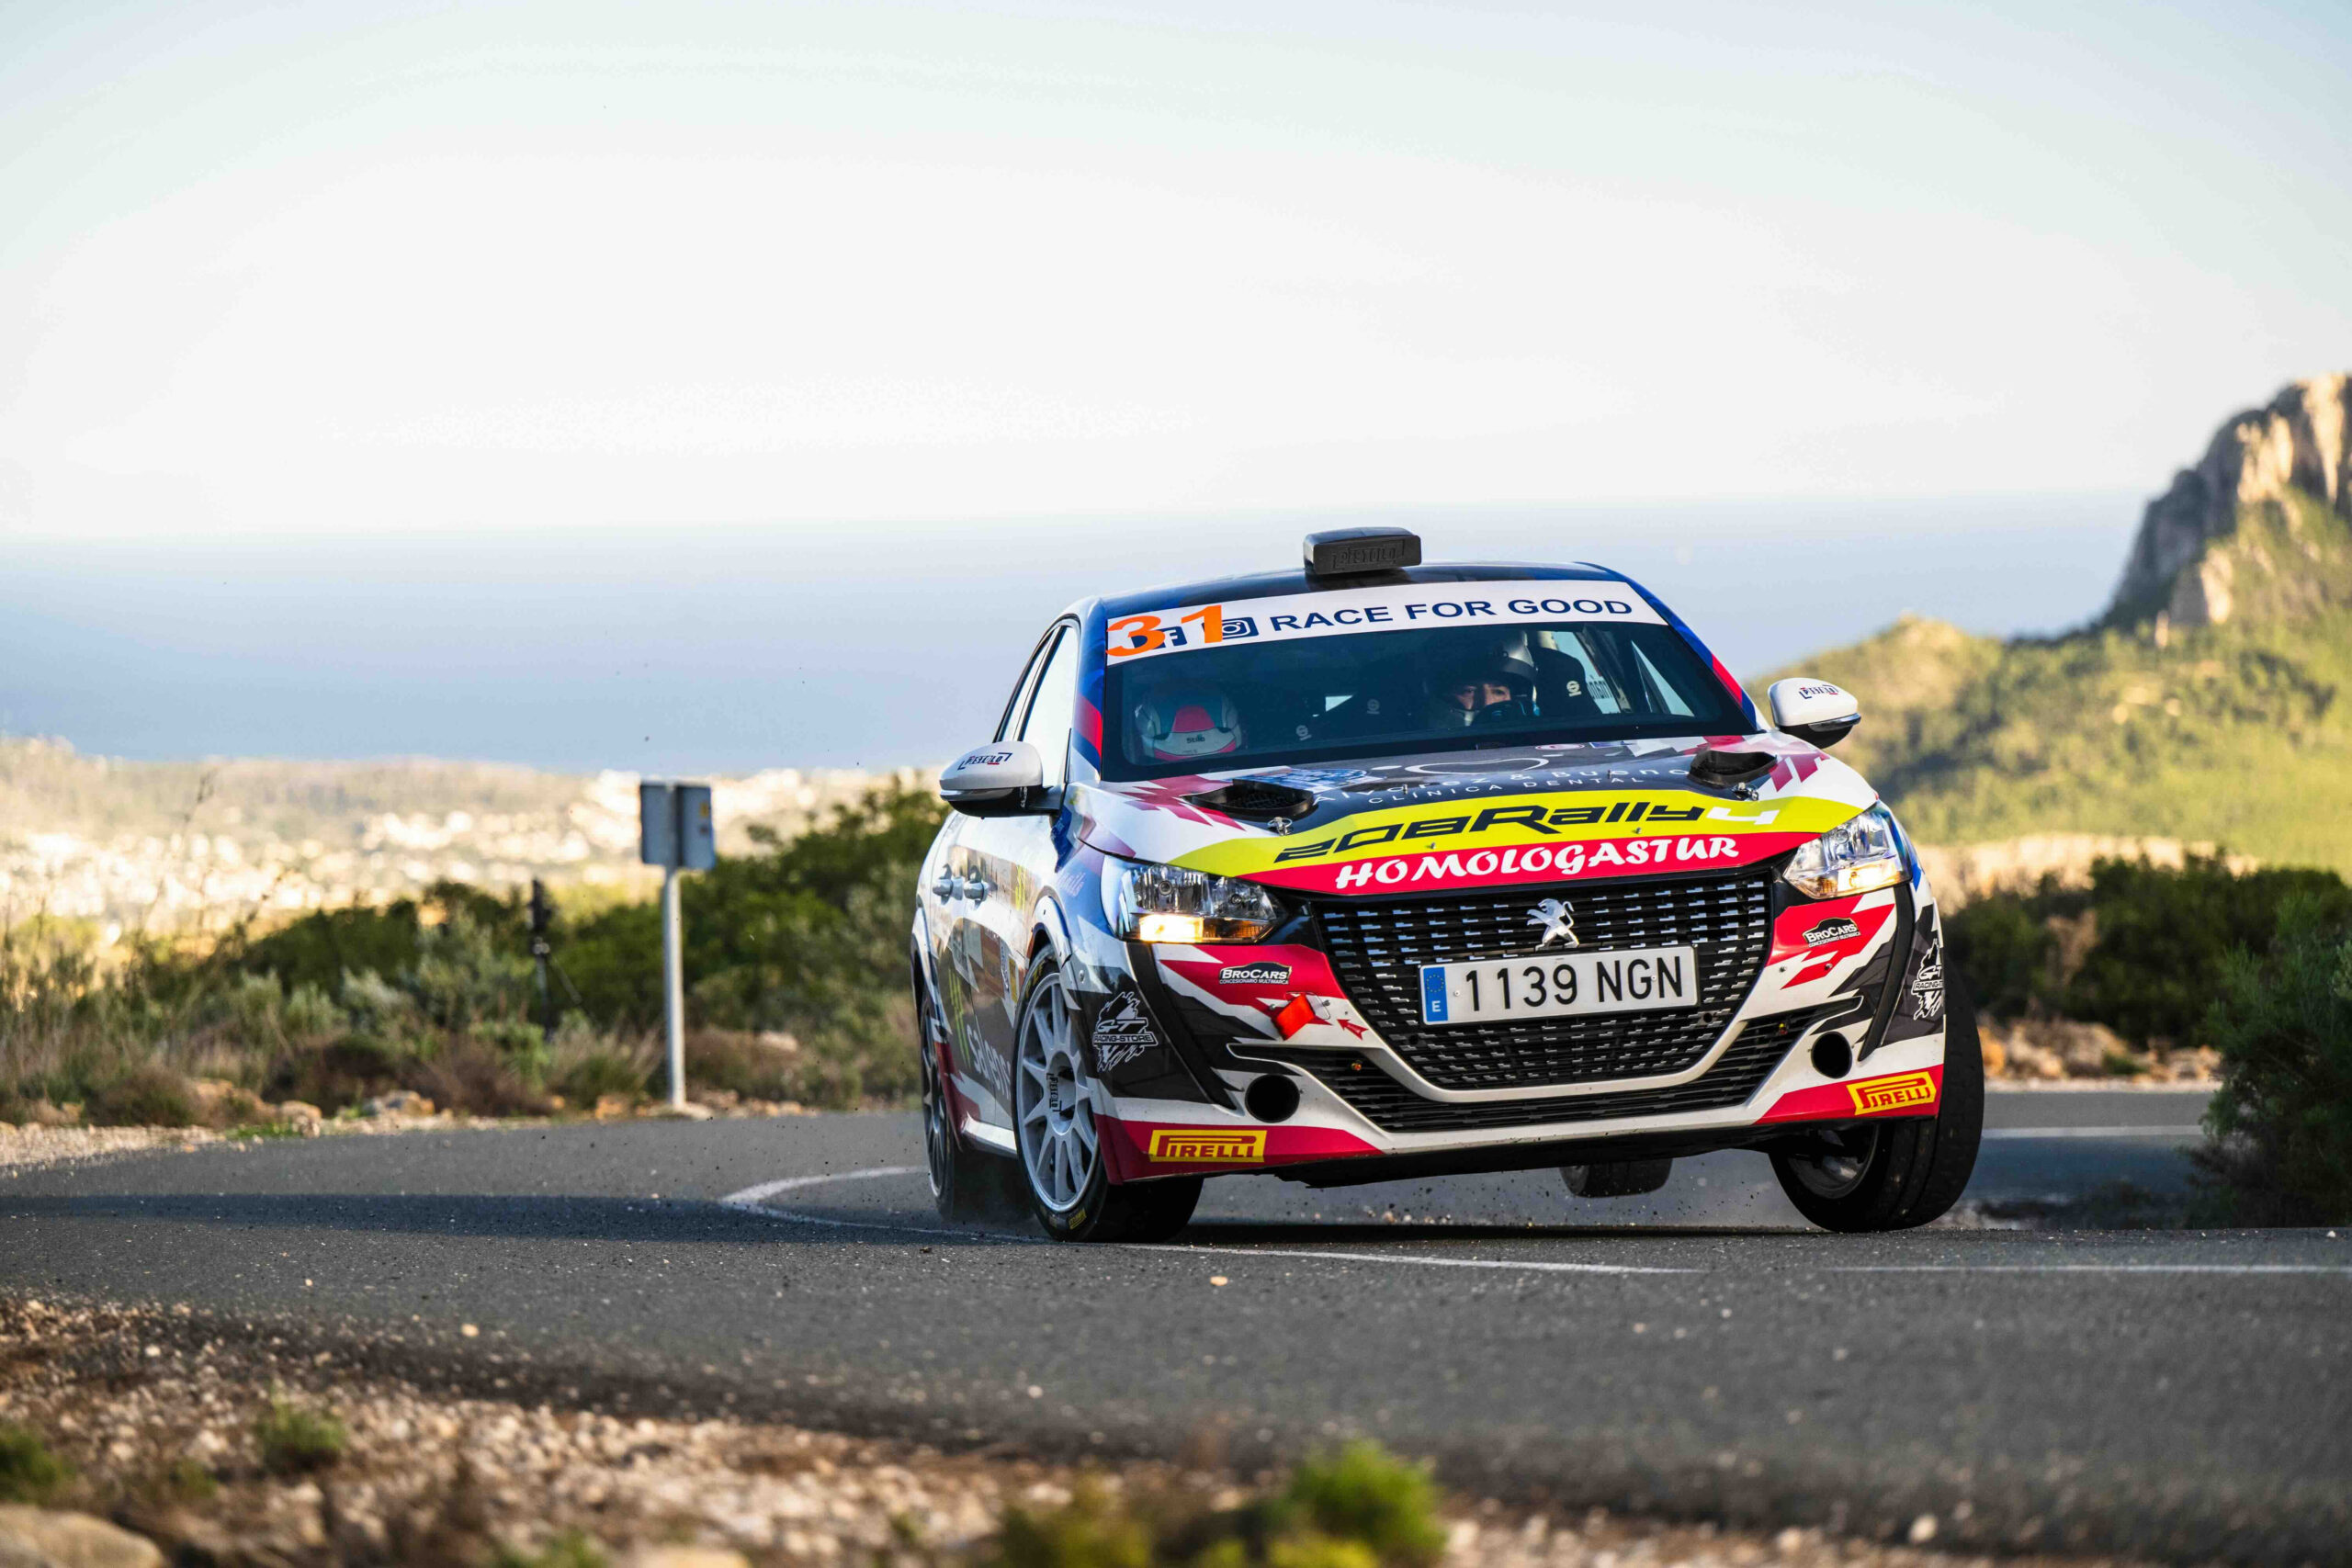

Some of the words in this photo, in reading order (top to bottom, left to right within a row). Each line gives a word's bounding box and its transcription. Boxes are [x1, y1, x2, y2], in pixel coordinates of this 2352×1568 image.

[1105, 604, 1223, 657] 31
[1270, 606, 1394, 631] RACE
[1405, 602, 1498, 619] FOR
[1507, 599, 1633, 615] GOOD
[1522, 777, 1645, 788] DENTAL
[1551, 769, 1690, 778] Bueno
[1335, 837, 1740, 889] HOMOLOGASTUR
[1431, 1000, 1442, 1012] E
[1465, 964, 1577, 1012] 1139
[1596, 956, 1683, 1003] NGN
[1856, 1077, 1931, 1110] PIRELLI
[1156, 1134, 1257, 1157] PIRELLI
